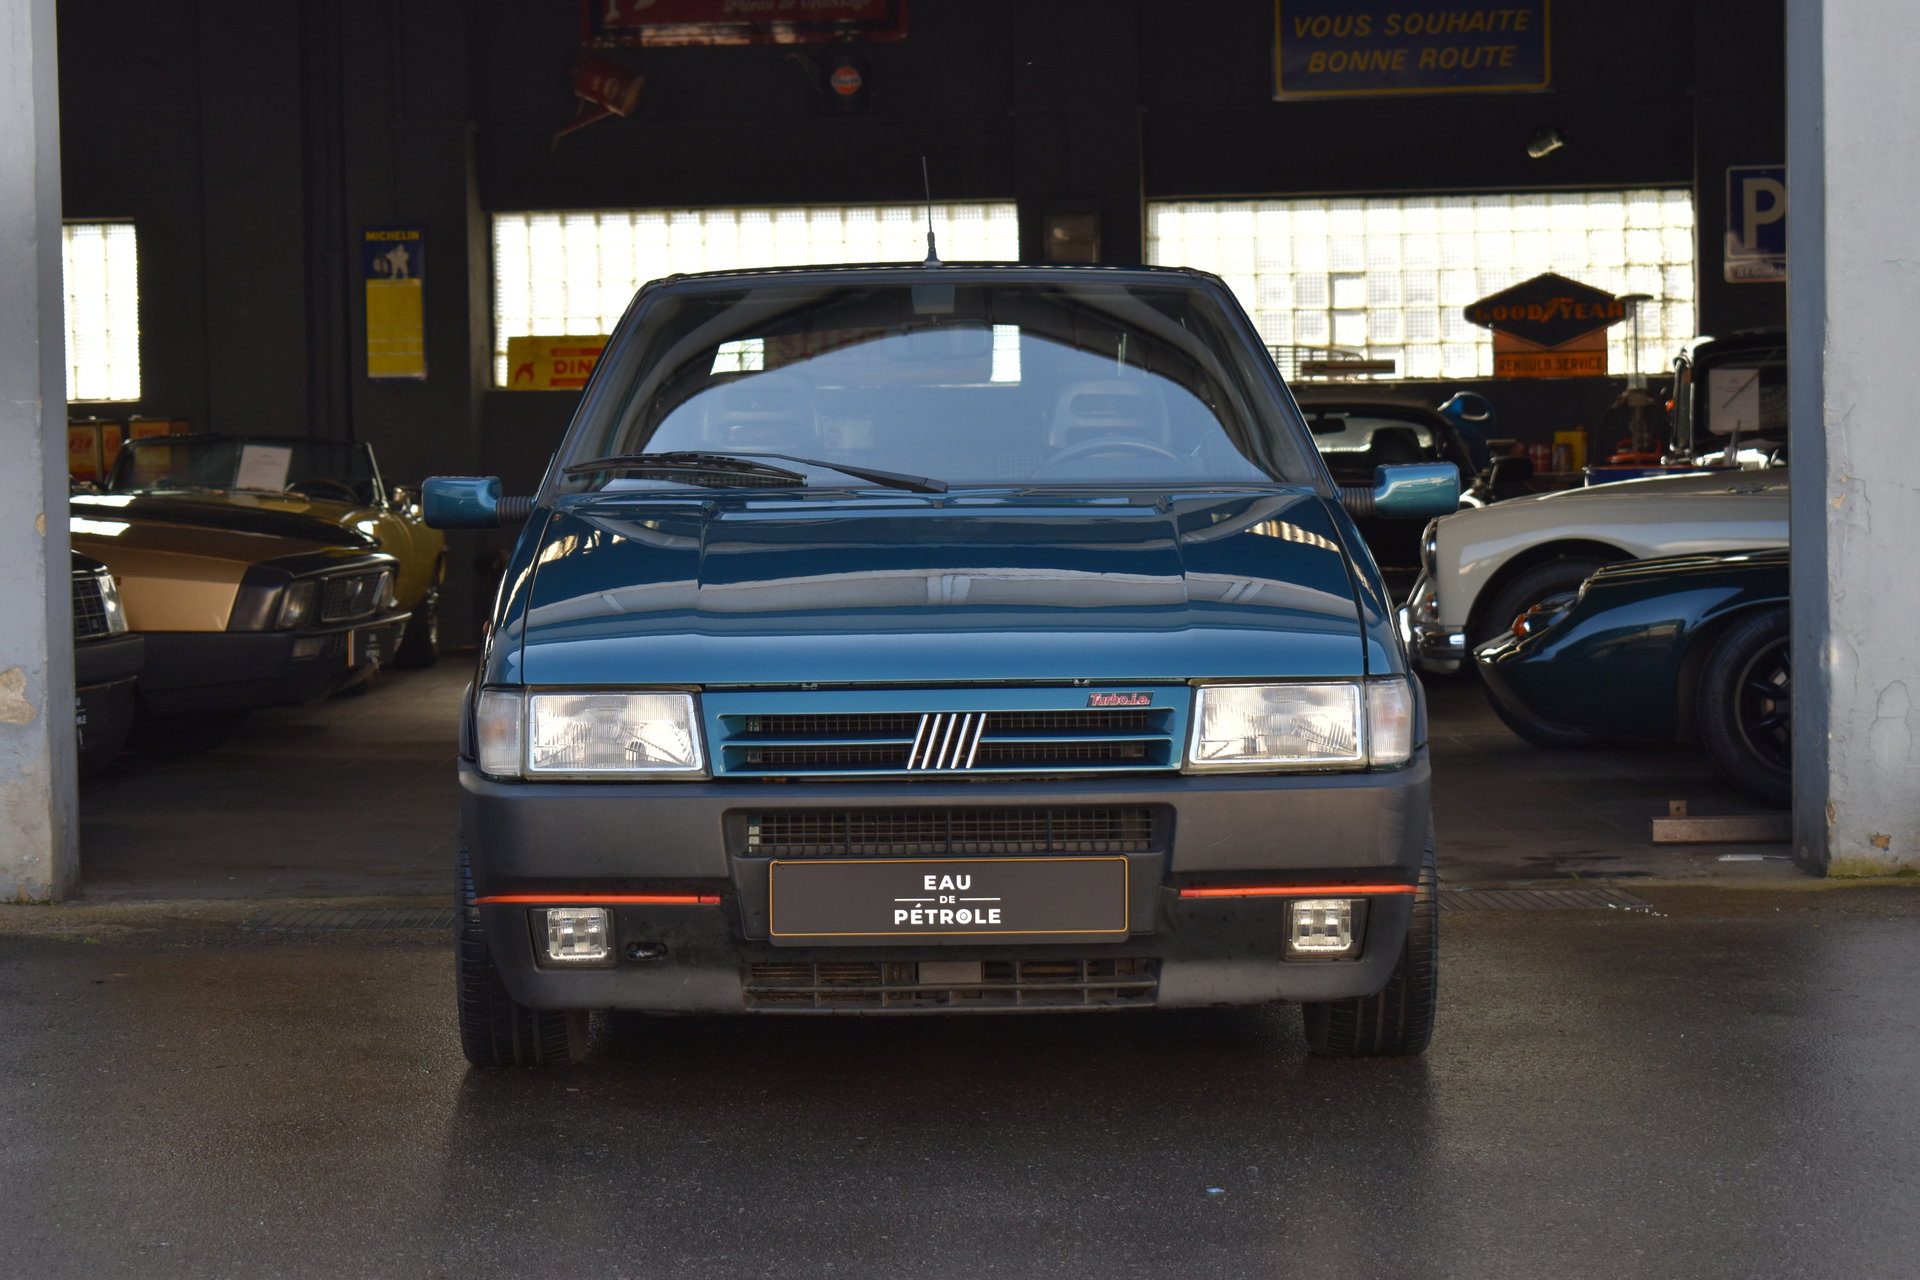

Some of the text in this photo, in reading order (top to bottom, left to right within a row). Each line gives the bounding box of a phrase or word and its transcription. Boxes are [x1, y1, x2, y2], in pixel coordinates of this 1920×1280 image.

[1294, 9, 1532, 39] VOUS SOUHAITE
[1308, 46, 1517, 73] BONNE ROUTE
[1743, 178, 1786, 249] P
[365, 231, 420, 242] MICHELIN
[1474, 298, 1624, 323] GOODYEAR
[1499, 356, 1603, 372] REMOULD SERVICE
[924, 875, 972, 890] EAU
[939, 895, 956, 904] DE
[894, 903, 1001, 925] PÉTROLE
